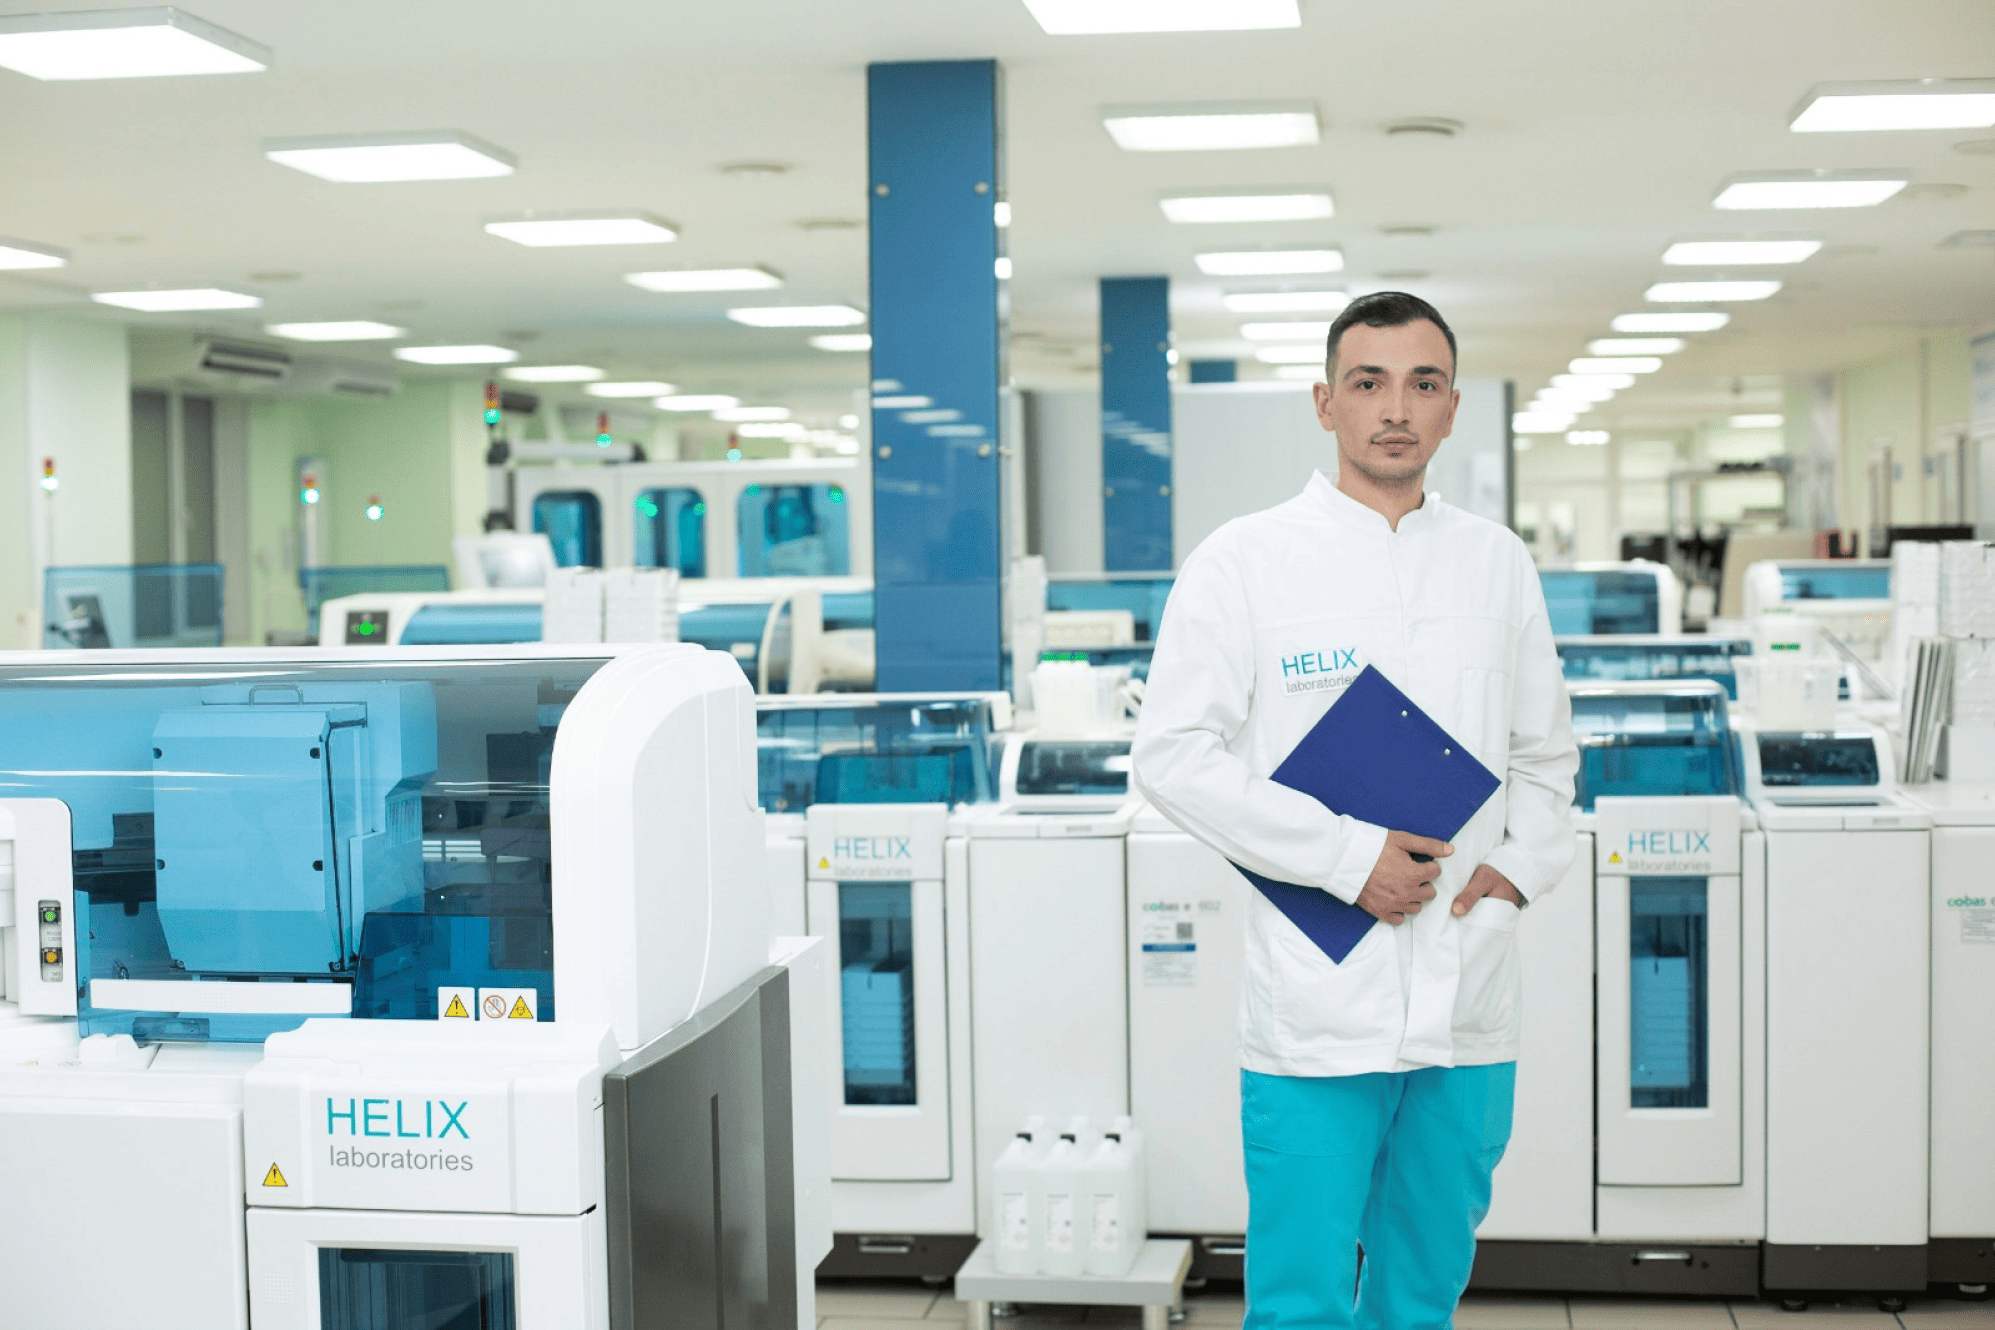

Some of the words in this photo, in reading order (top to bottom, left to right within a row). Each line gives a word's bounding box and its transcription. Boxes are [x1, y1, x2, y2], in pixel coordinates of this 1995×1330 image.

[1281, 647, 1358, 677] HELIX
[834, 837, 912, 859] HELIX
[1628, 831, 1711, 854] HELIX
[834, 866, 913, 876] laboratories
[1628, 858, 1711, 871] laboratories
[1142, 899, 1179, 911] cobas
[326, 1097, 470, 1139] HELIX
[330, 1144, 474, 1171] laboratories
